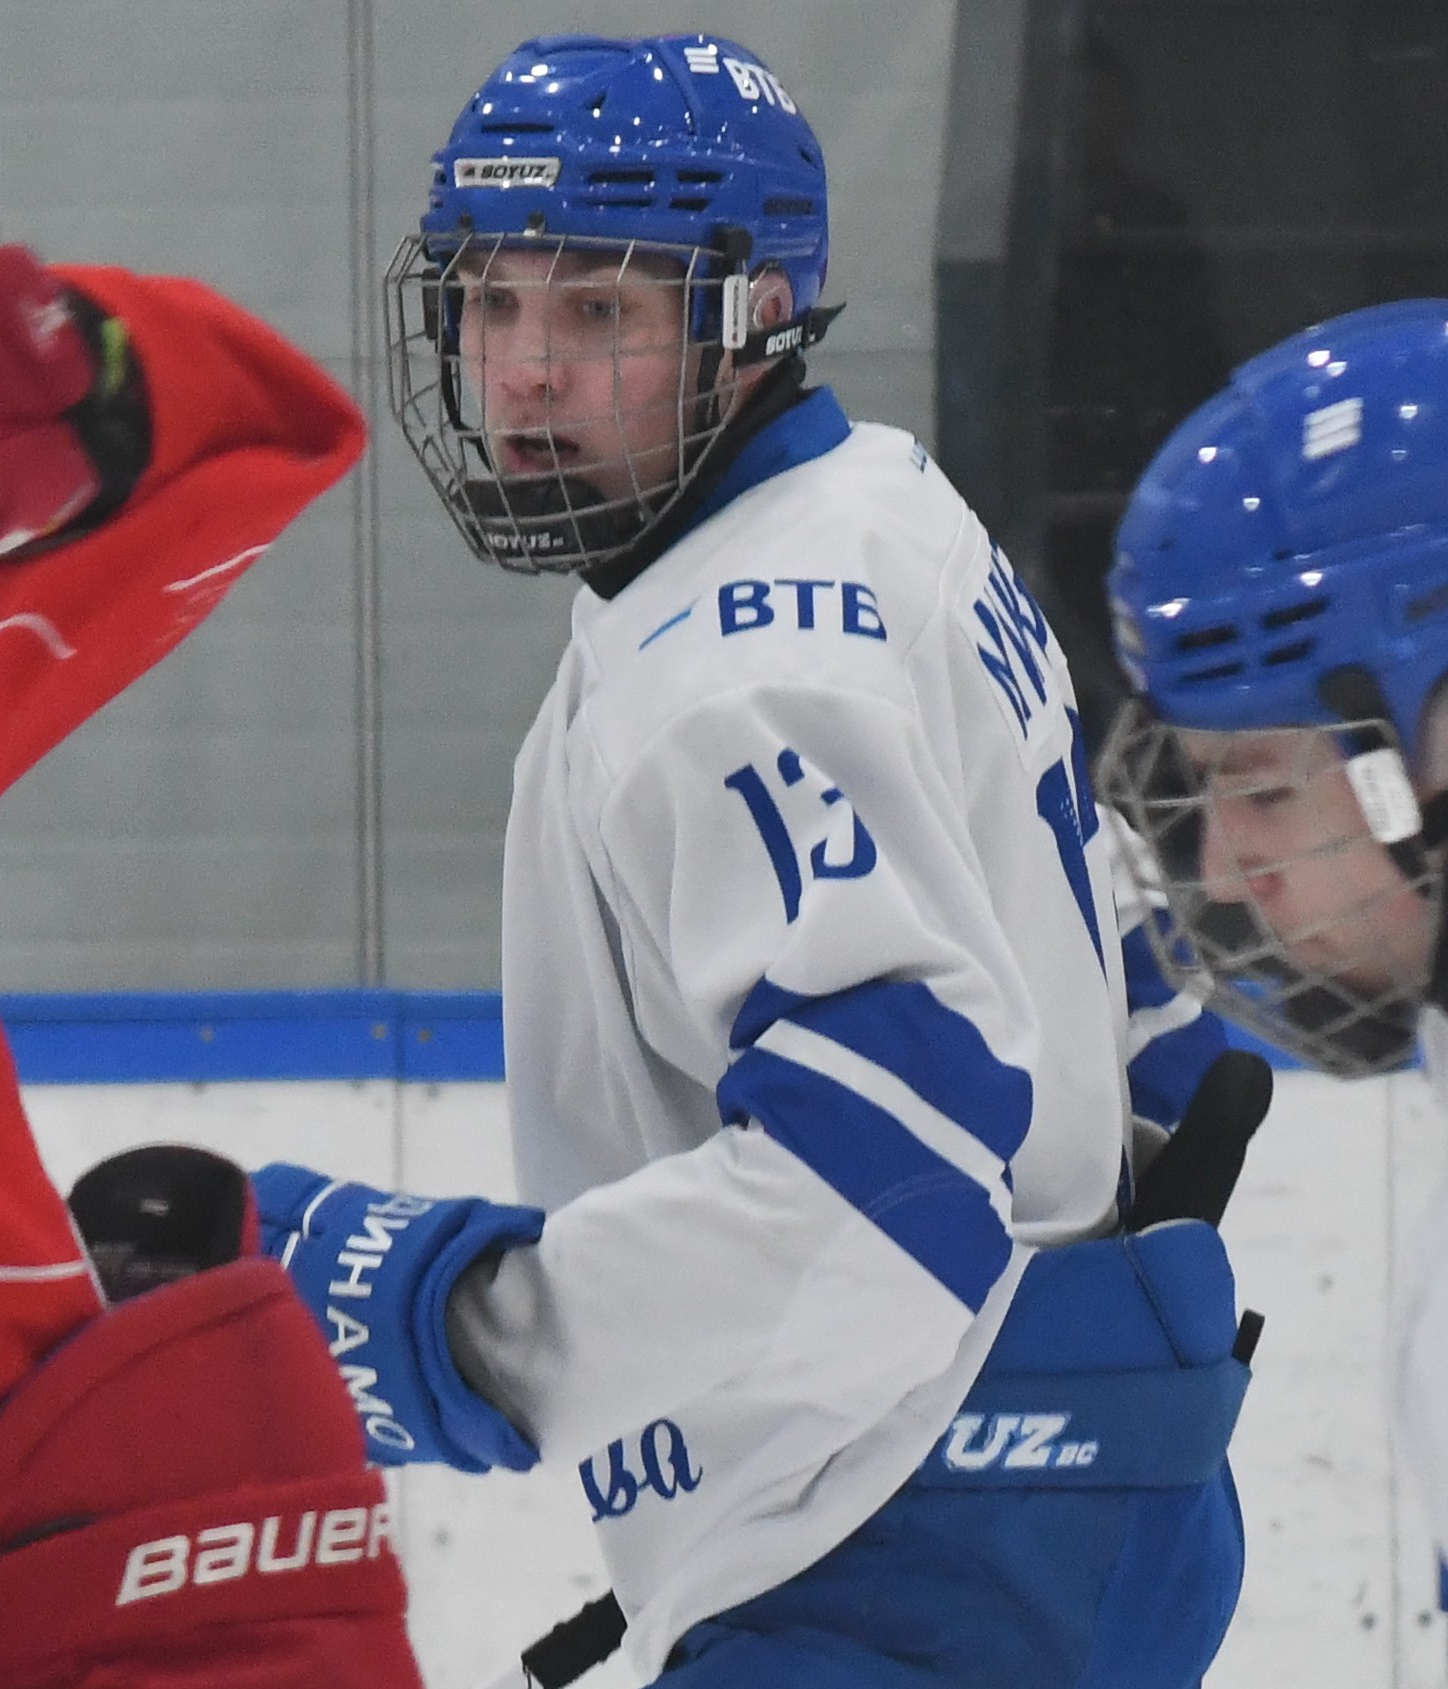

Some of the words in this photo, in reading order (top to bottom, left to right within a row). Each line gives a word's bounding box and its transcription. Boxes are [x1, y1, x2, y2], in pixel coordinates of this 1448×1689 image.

[717, 578, 887, 644] ВТБ
[723, 746, 878, 926] 13
[326, 1195, 434, 1452] ДИНАМО
[115, 1503, 399, 1607] BAUER
